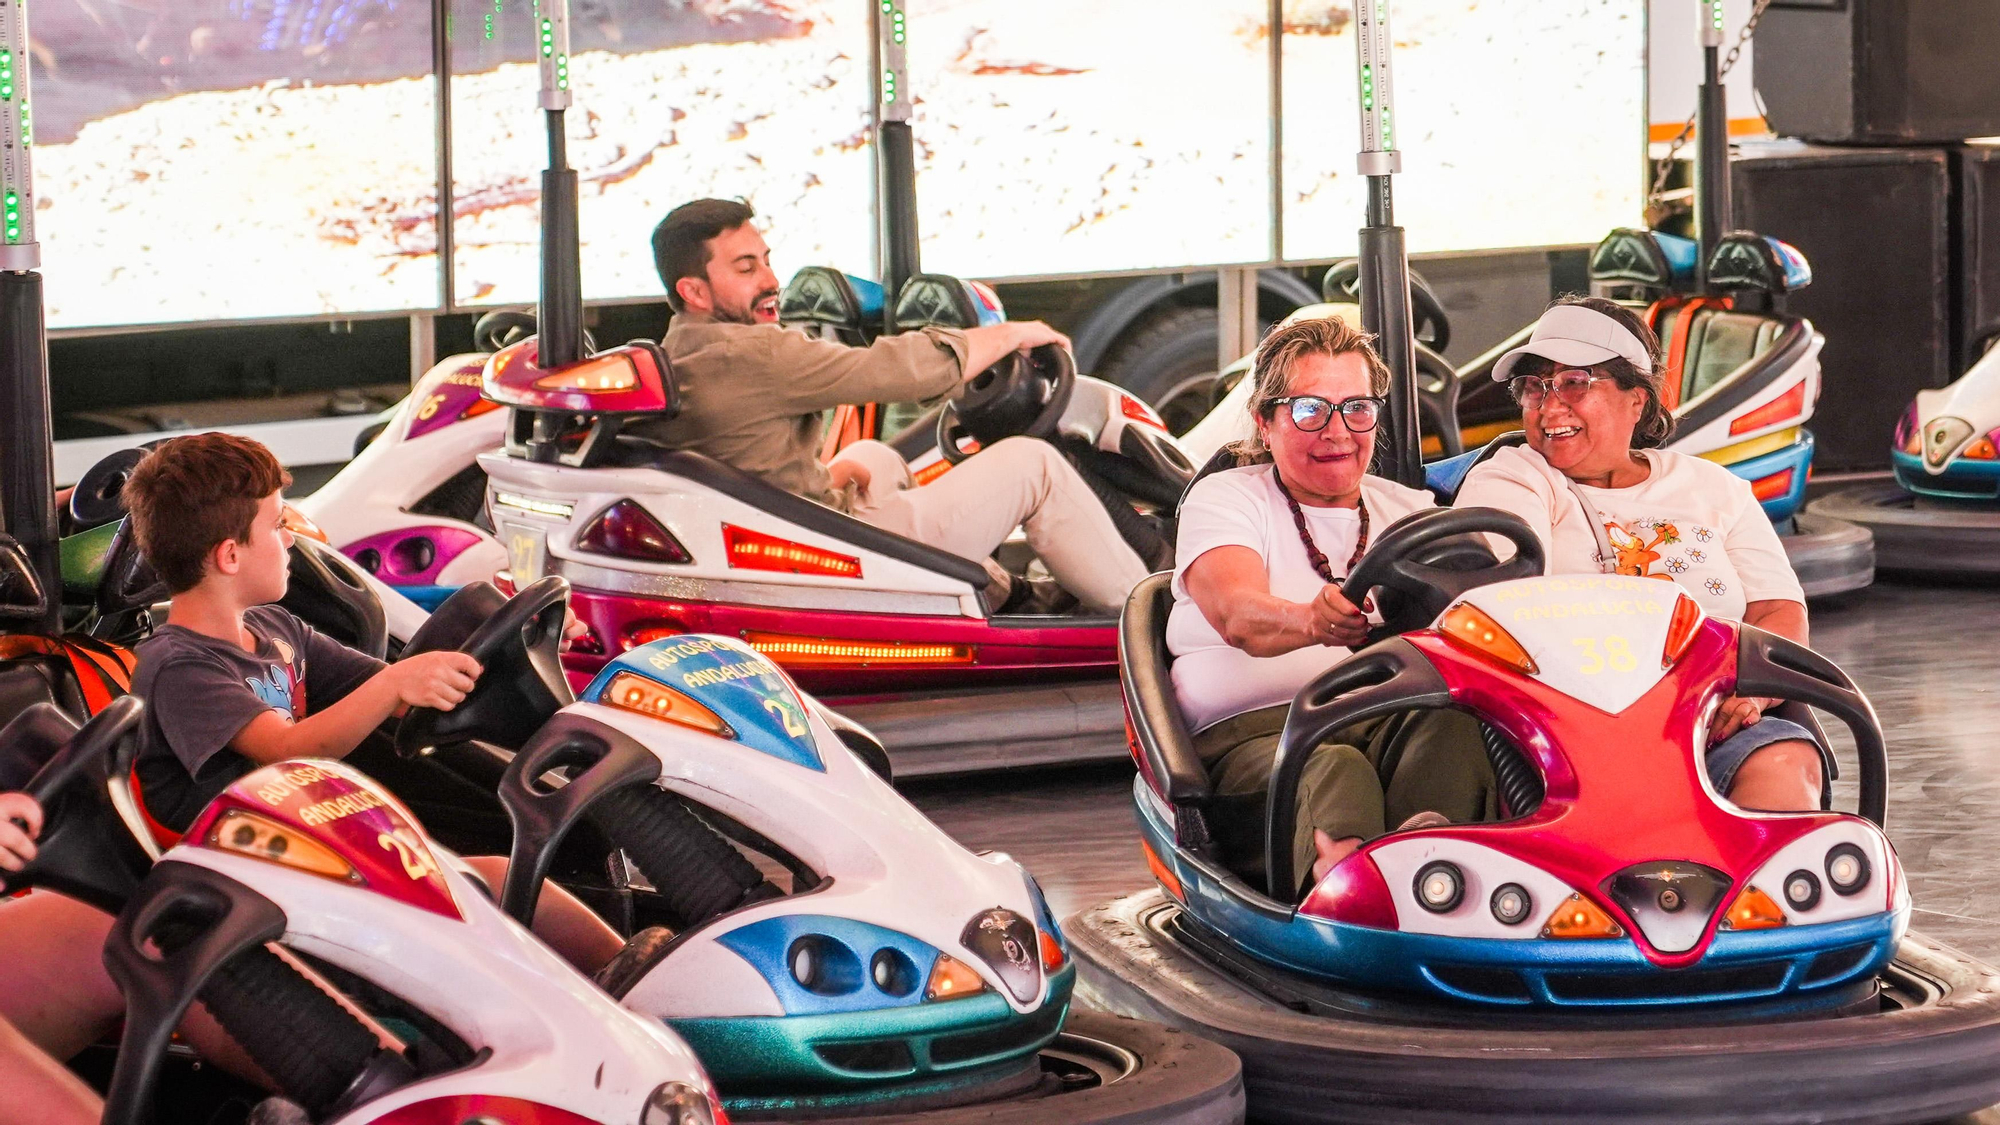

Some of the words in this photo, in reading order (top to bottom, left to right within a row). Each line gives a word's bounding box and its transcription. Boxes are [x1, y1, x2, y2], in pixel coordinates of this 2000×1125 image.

[1496, 578, 1656, 602] AUTOSPORT
[1513, 599, 1664, 622] ANDALUCIA
[1572, 634, 1638, 675] 38
